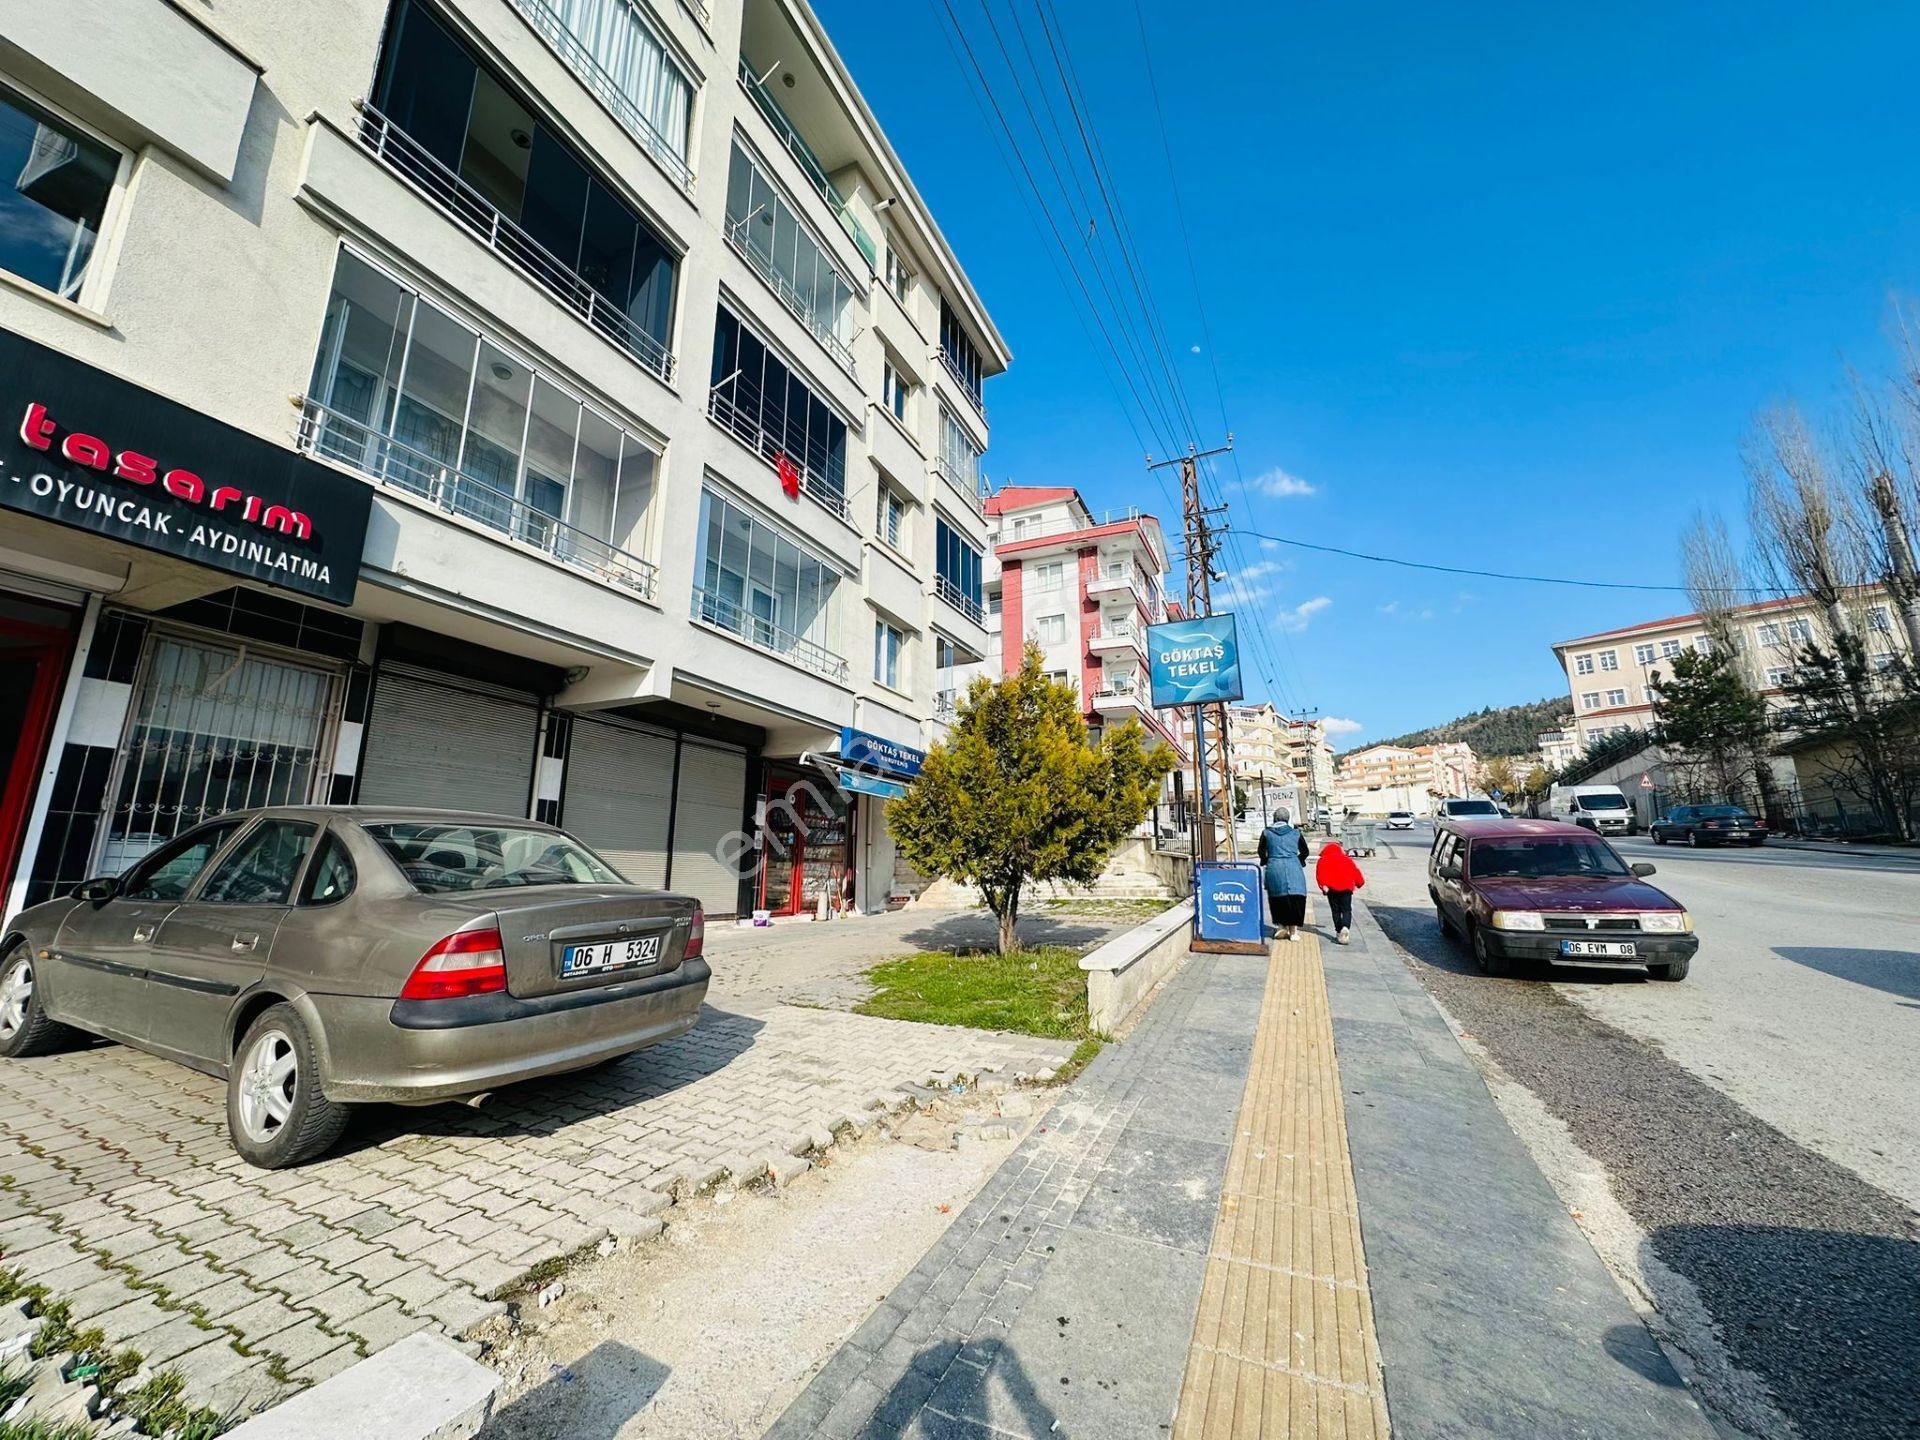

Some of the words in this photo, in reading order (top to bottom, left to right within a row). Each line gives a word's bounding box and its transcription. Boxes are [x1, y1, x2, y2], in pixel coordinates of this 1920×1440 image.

[31, 473, 171, 535] OYUNCAK
[189, 524, 331, 585] AYDINLATMA
[1160, 645, 1225, 665] GÖKTAŞ
[1168, 660, 1219, 678] TEKEL
[867, 740, 898, 758] GÖKTAŞ
[899, 750, 921, 764] TEKEL
[1212, 892, 1246, 904] GÖKTAŞ
[1216, 905, 1244, 914] TEKEL
[574, 947, 593, 967] 06
[602, 944, 613, 964] H
[626, 938, 657, 960] 5324
[1569, 942, 1581, 953] 06
[1587, 943, 1607, 954] EVM
[1620, 944, 1634, 955] 08
